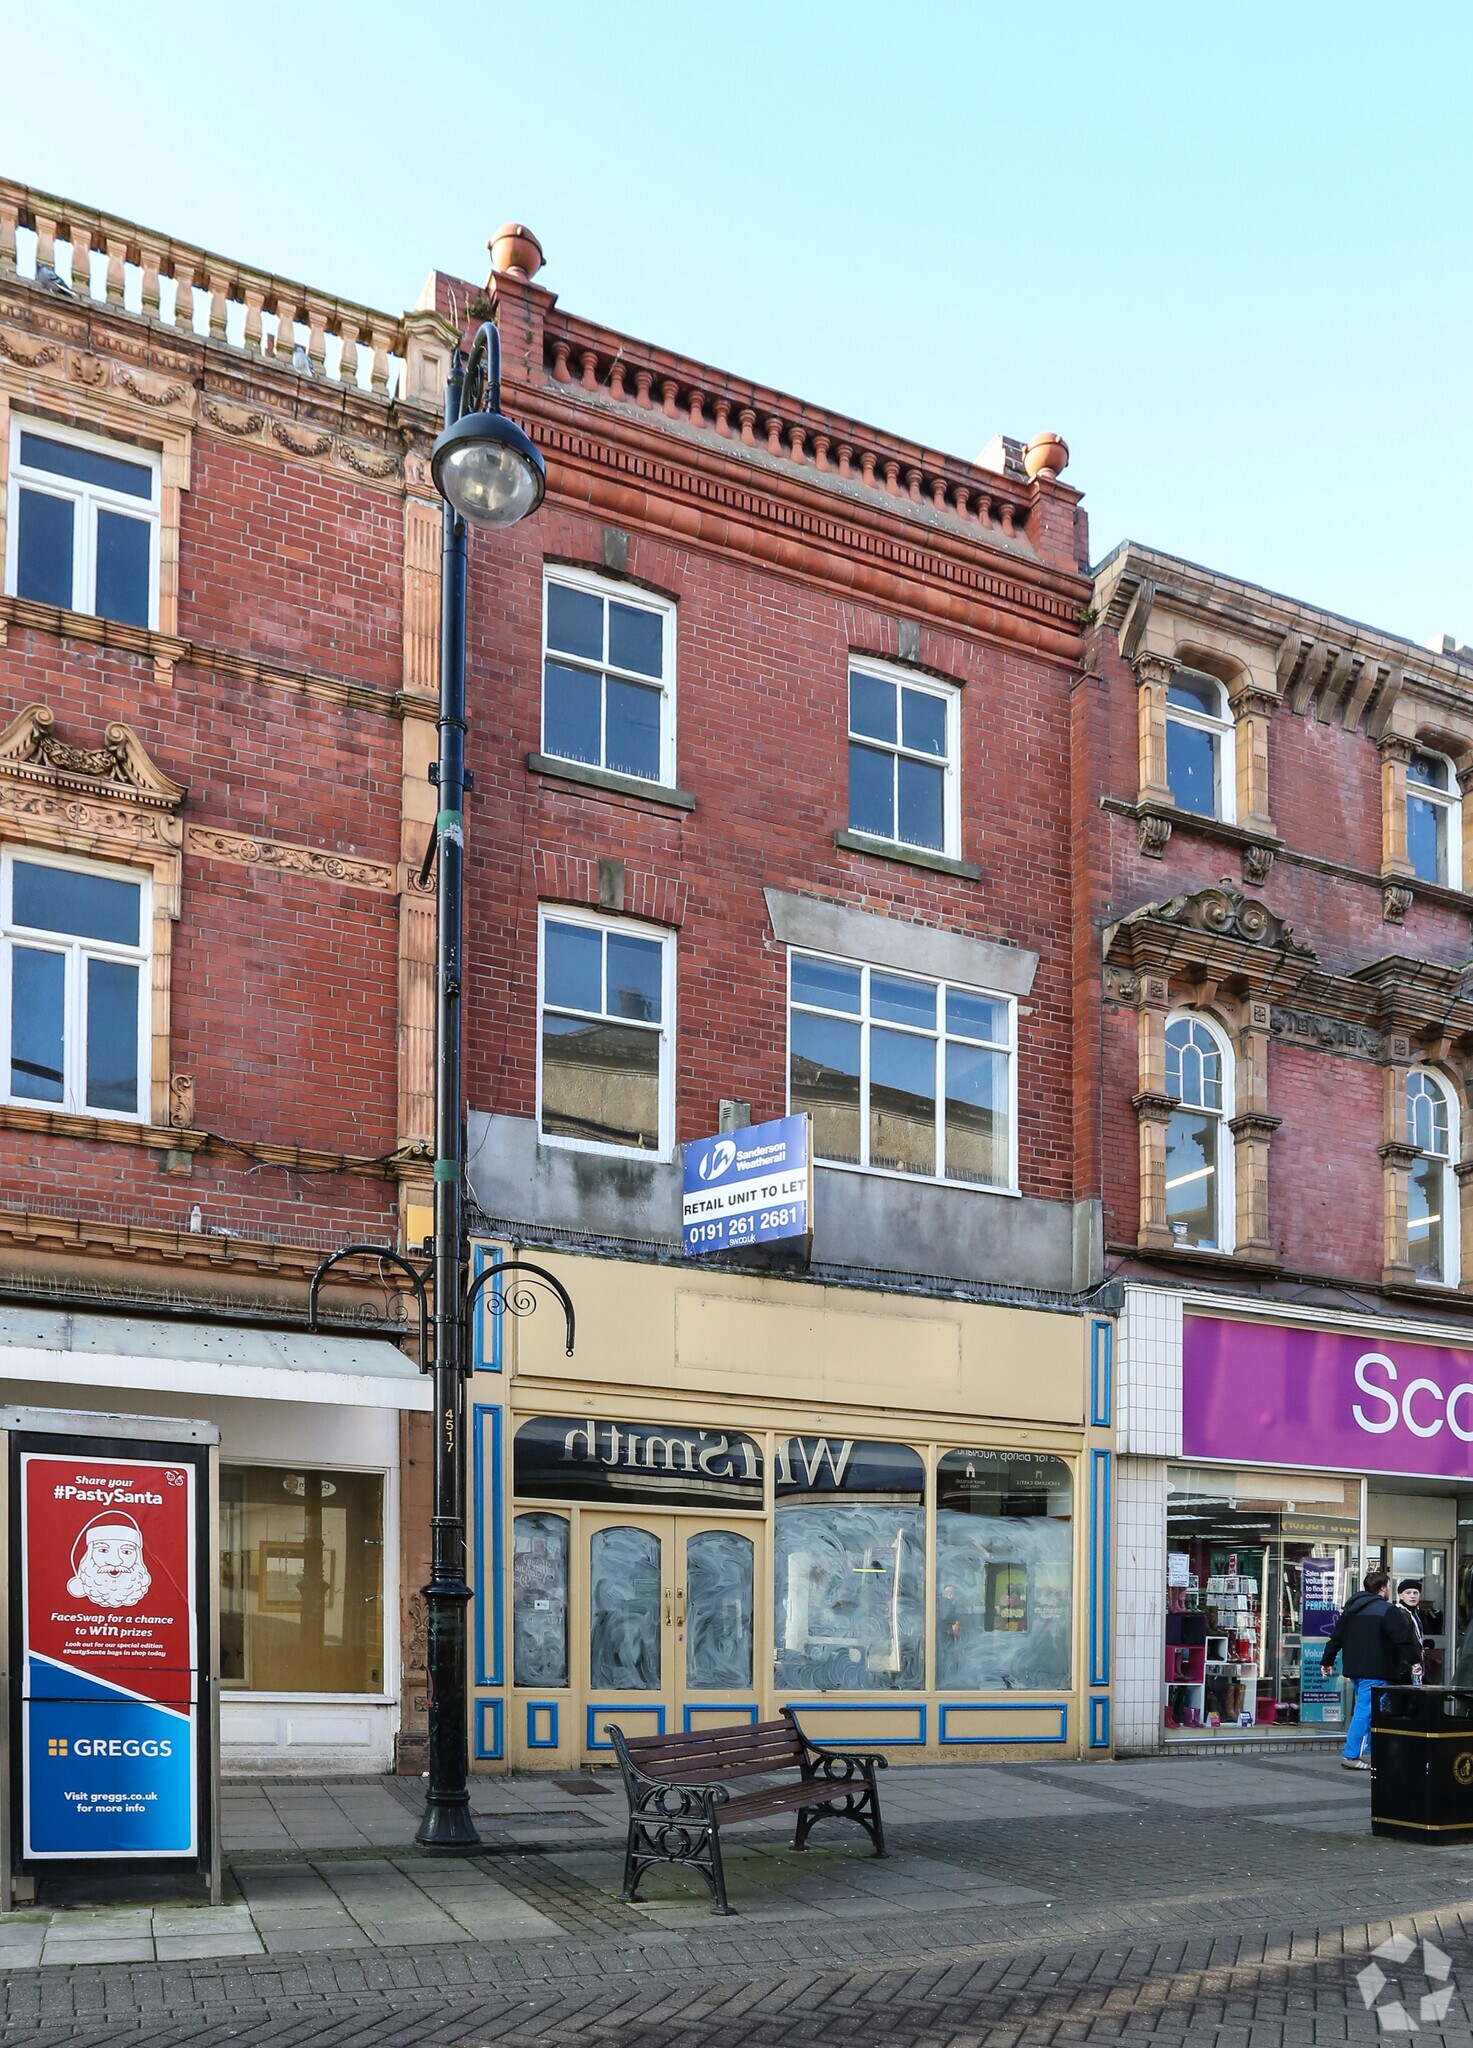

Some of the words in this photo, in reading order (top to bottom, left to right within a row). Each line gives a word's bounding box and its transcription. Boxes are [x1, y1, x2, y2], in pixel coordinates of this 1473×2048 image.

[736, 1142, 786, 1160] Sanderson
[736, 1152, 786, 1171] Weatherall
[684, 1198, 724, 1216] RETAIL
[728, 1190, 757, 1206] UNIT
[761, 1185, 777, 1198] TO
[782, 1179, 806, 1194] LET
[689, 1222, 723, 1244] 0191
[728, 1215, 754, 1236] 261
[760, 1206, 797, 1230] 2681
[445, 1408, 454, 1453] 4517
[75, 1475, 106, 1486] Share
[108, 1478, 134, 1488] your
[53, 1485, 163, 1506] #PastySanta
[51, 1612, 105, 1624] FaceSwap
[107, 1613, 124, 1623] for
[135, 1615, 174, 1624] chance
[75, 1626, 86, 1635] to
[89, 1623, 118, 1636] win
[120, 1627, 153, 1638] prizes
[73, 1739, 173, 1757] GREGGS
[64, 1791, 88, 1801] Visit
[90, 1791, 158, 1802] greggs.co.uk
[77, 1803, 93, 1812] for
[95, 1804, 123, 1812] more
[125, 1803, 145, 1812] info
